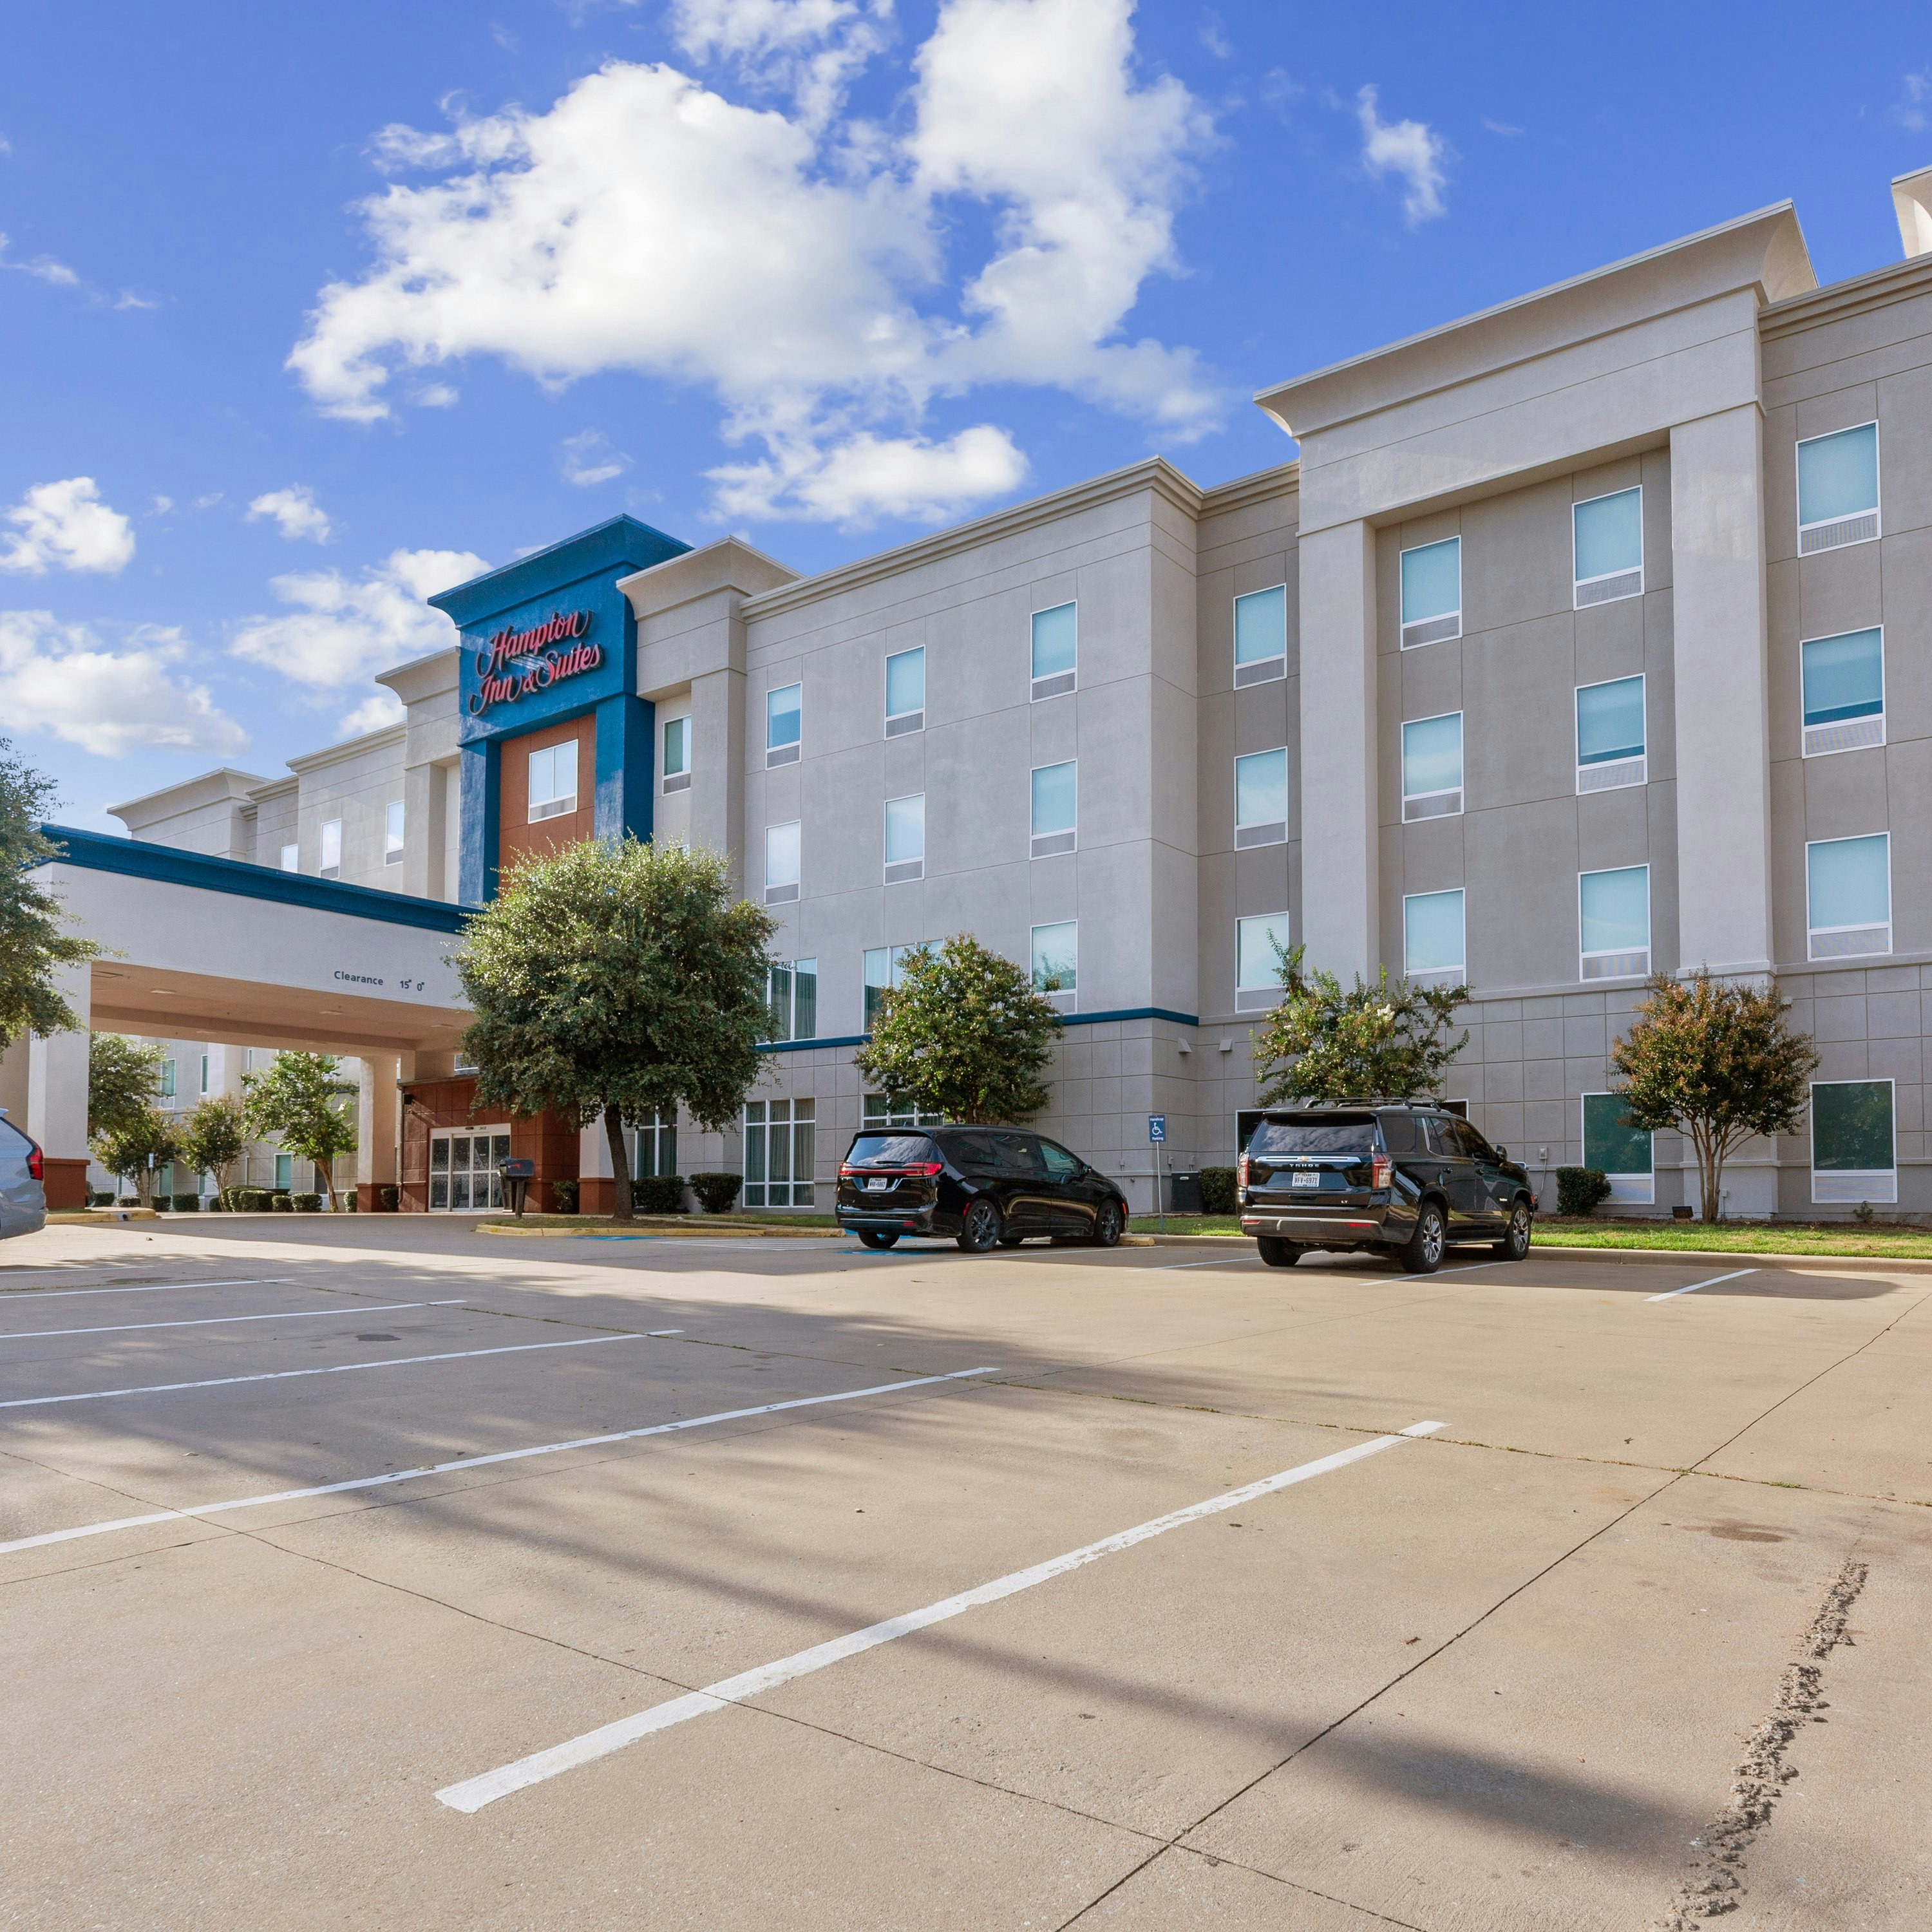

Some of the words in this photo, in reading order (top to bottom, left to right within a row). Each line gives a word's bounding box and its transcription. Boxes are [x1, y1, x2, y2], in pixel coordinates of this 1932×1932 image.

[477, 609, 594, 677] Hampton
[469, 674, 523, 715] Inn
[523, 672, 538, 693] &
[536, 642, 605, 688] Suites
[334, 971, 384, 986] Clearance
